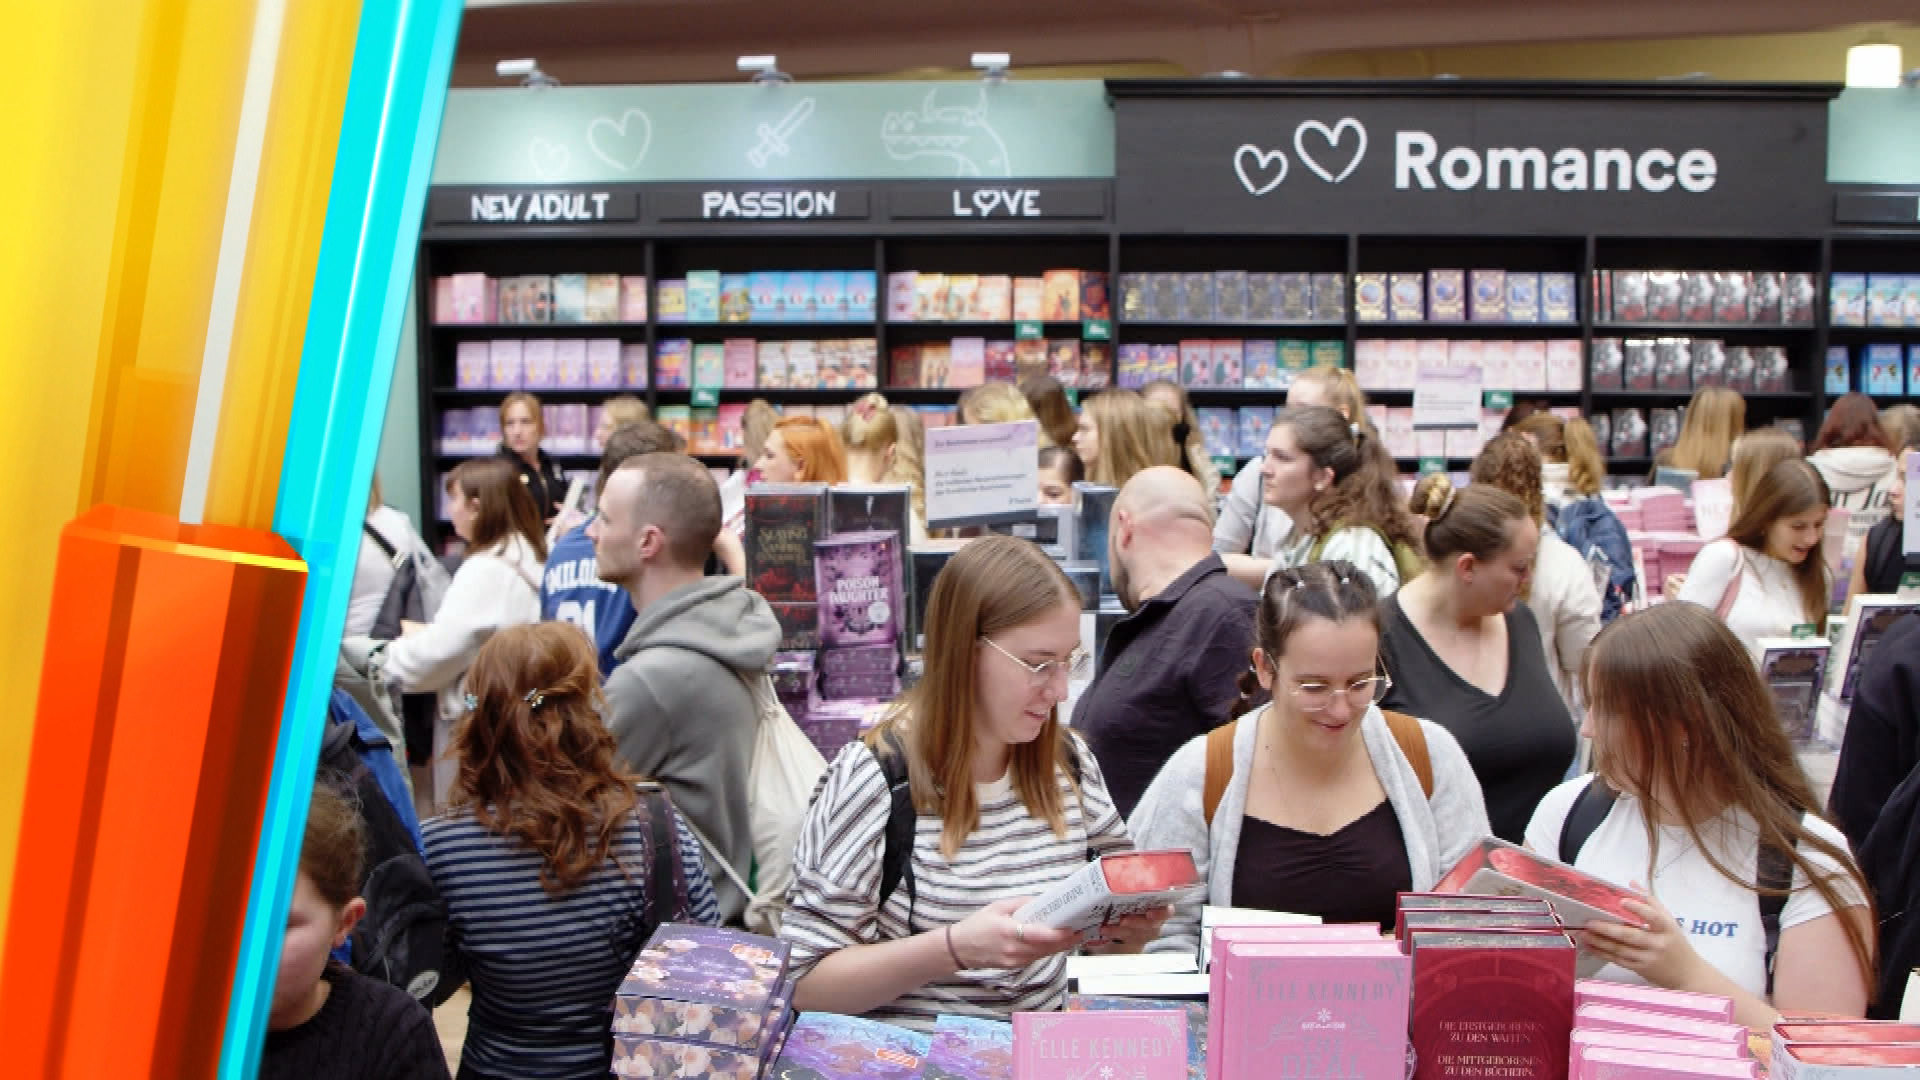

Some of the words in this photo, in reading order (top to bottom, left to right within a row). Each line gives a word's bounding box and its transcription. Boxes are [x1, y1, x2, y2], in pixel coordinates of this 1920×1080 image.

[1394, 130, 1718, 192] Romance
[471, 193, 524, 222] NEW
[524, 192, 611, 222] ADULT
[702, 191, 836, 218] PASSION
[952, 189, 1042, 218] LOVE
[1691, 919, 1739, 938] HOT
[1308, 981, 1395, 1001] KENNEDY
[1439, 1021, 1457, 1031] DIE
[1039, 1039, 1081, 1059] ELLE
[1089, 1037, 1173, 1058] KENNEDY
[1450, 1033, 1464, 1043] ZU
[1466, 1033, 1488, 1043] DEN
[1281, 1055, 1365, 1080] DEAL
[1437, 1055, 1455, 1065] DIE
[1457, 1055, 1544, 1065] MITTGEBORENEN
[1444, 1066, 1458, 1077] ZU
[1461, 1066, 1482, 1077] DEN
